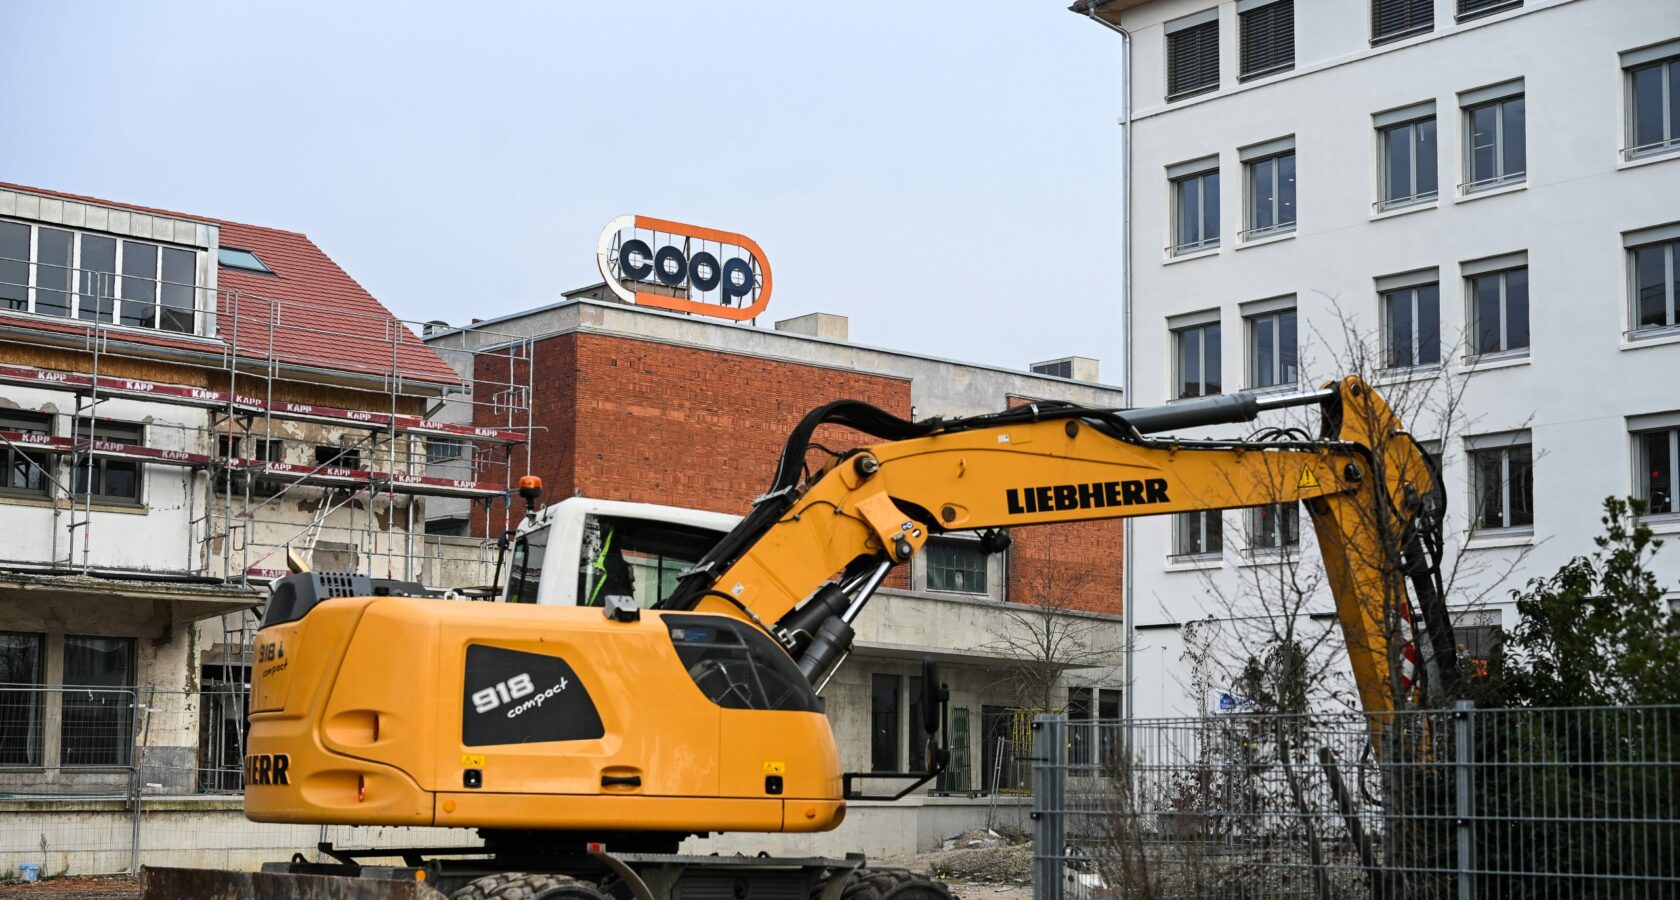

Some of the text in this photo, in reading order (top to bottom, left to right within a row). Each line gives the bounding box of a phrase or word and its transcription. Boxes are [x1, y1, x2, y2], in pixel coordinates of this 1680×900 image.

[619, 239, 754, 304] coop
[38, 371, 67, 382] KAPP
[126, 381, 154, 391] KAPP
[192, 389, 219, 400] KAPP
[235, 395, 262, 406] KAPP
[286, 403, 312, 414] KAPP
[347, 411, 372, 421] KAPP
[419, 420, 444, 431] KAPP
[475, 427, 498, 437] KAPP
[21, 433, 50, 444] KAPP
[95, 441, 124, 451] KAPP
[161, 450, 189, 460] KAPP
[267, 461, 292, 471] KAPP
[327, 467, 351, 477] KAPP
[398, 474, 422, 484] KAPP
[453, 479, 477, 489] KAPP
[1006, 478, 1170, 514] LIEBHERR
[259, 643, 276, 664] 918
[472, 673, 534, 713] 918
[507, 677, 568, 718] compact
